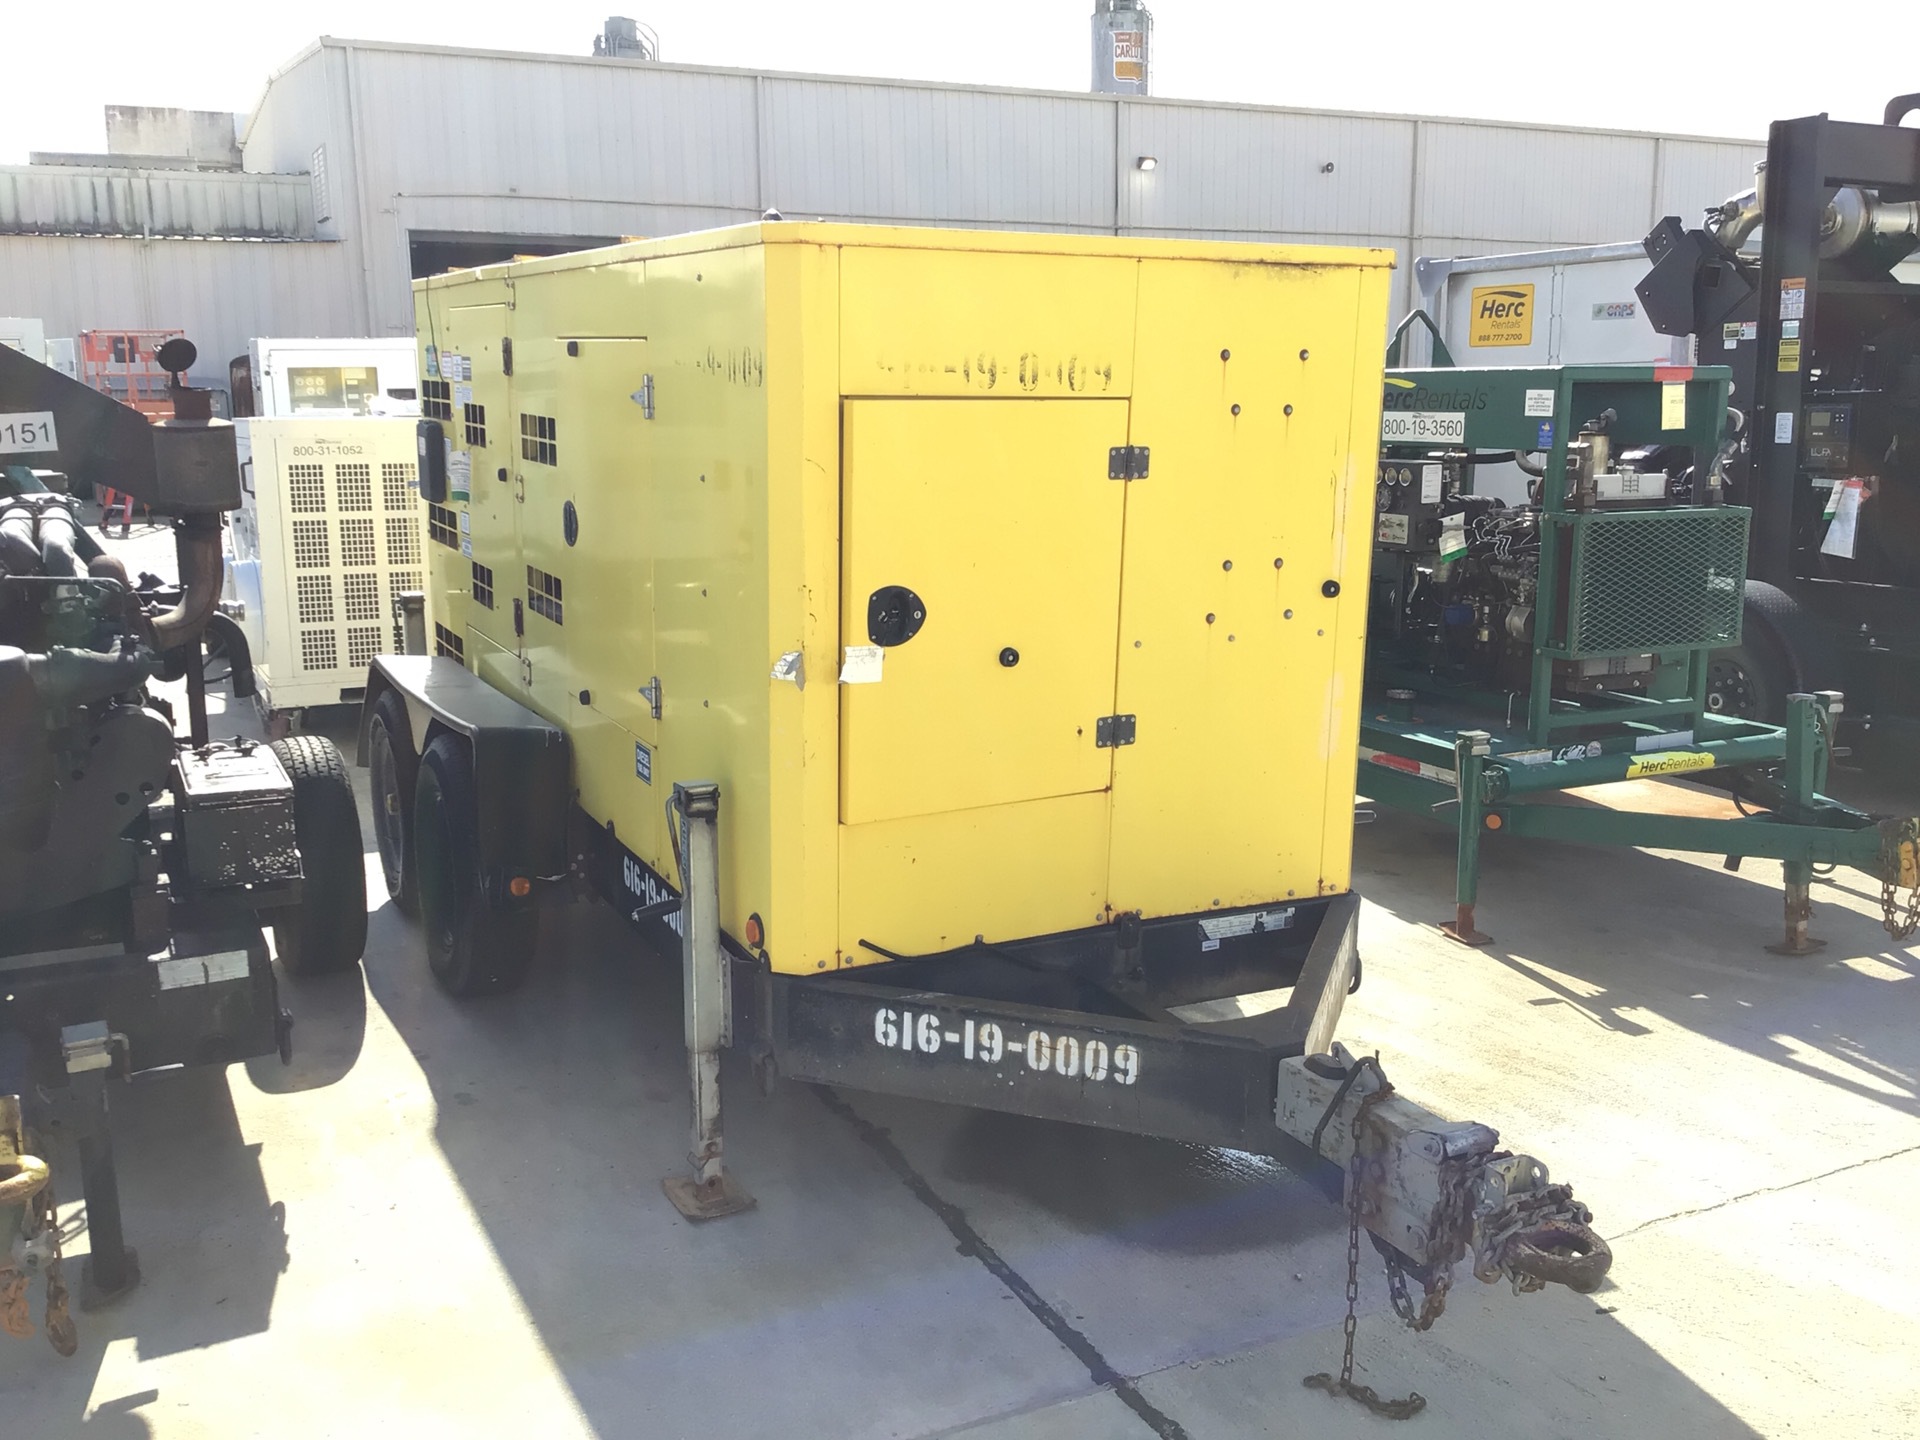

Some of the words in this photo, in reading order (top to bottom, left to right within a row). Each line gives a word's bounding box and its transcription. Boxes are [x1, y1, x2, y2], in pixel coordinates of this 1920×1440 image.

[1480, 299, 1525, 319] Herc
[1490, 319, 1521, 330] Rentals
[0, 421, 50, 445] 151
[1383, 419, 1463, 437] 800-19-3560
[293, 446, 363, 456] 800-31-1052
[1639, 756, 1706, 774] HercRentals
[874, 1008, 1138, 1085] 616-19-0009
